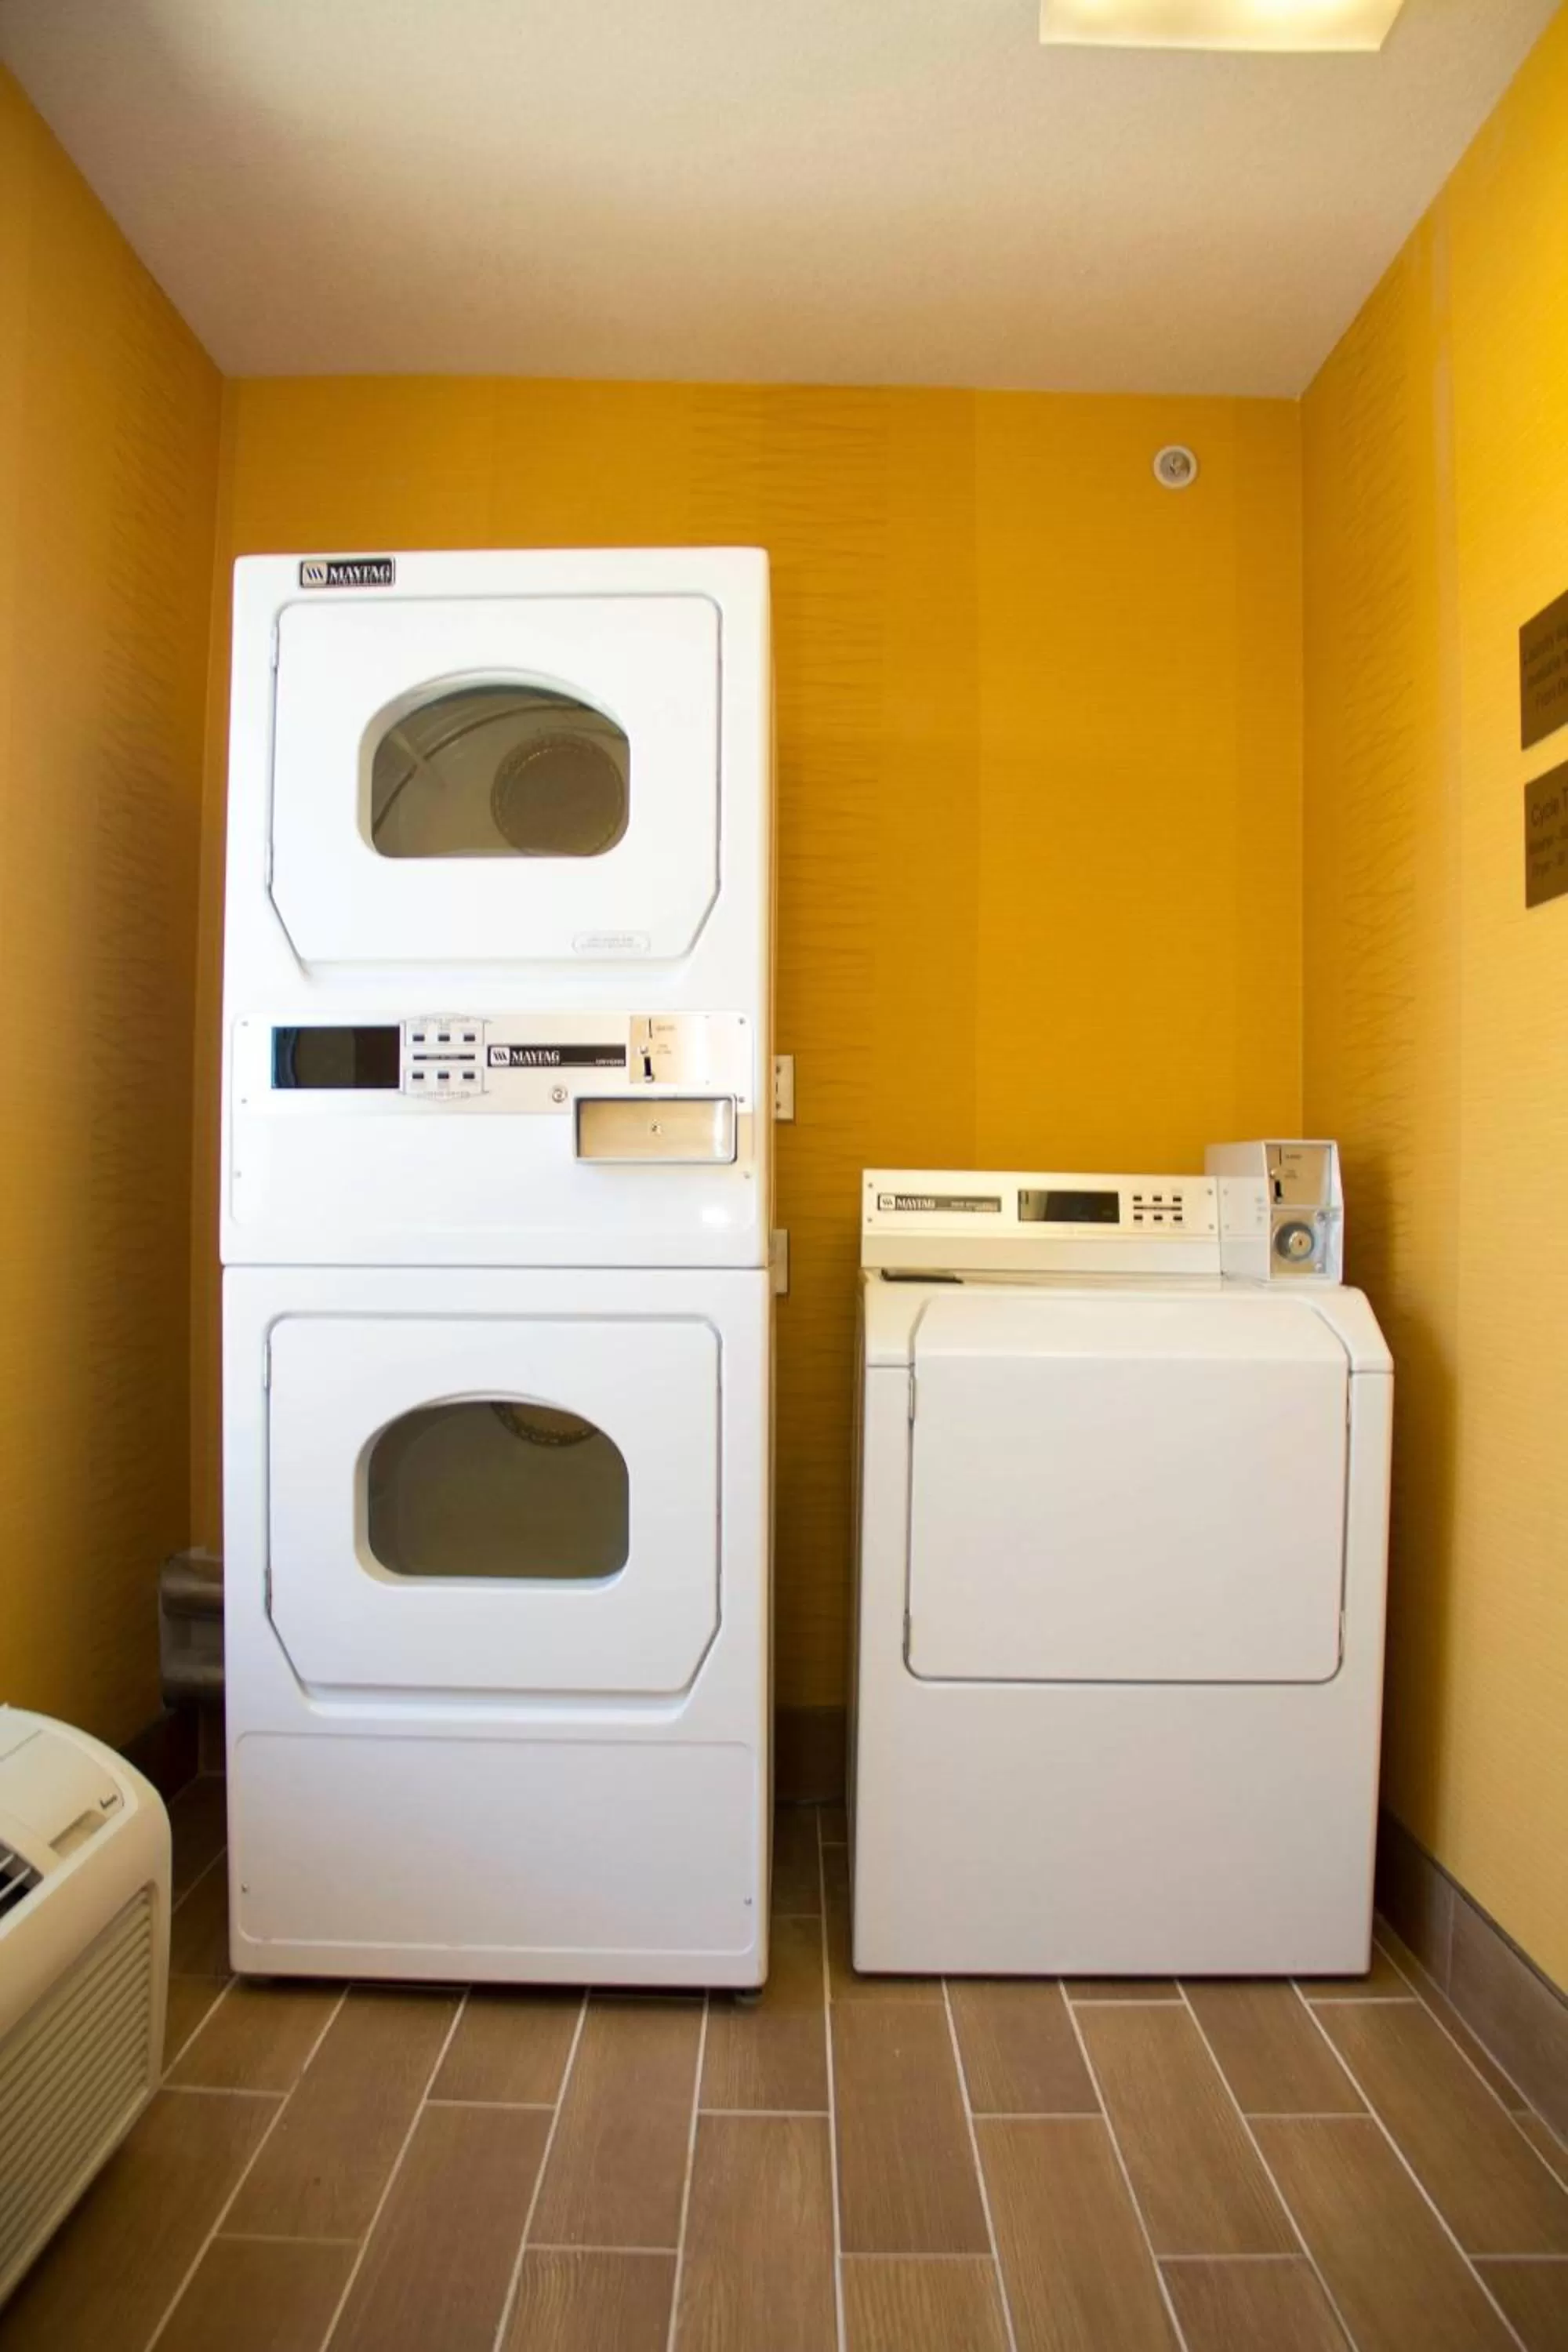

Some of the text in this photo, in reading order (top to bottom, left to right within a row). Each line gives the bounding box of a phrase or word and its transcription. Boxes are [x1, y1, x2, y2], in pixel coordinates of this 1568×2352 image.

[329, 564, 390, 584] MAYTAG
[510, 1051, 561, 1065] MAYTAG
[896, 1198, 936, 1210] MAYTAG
